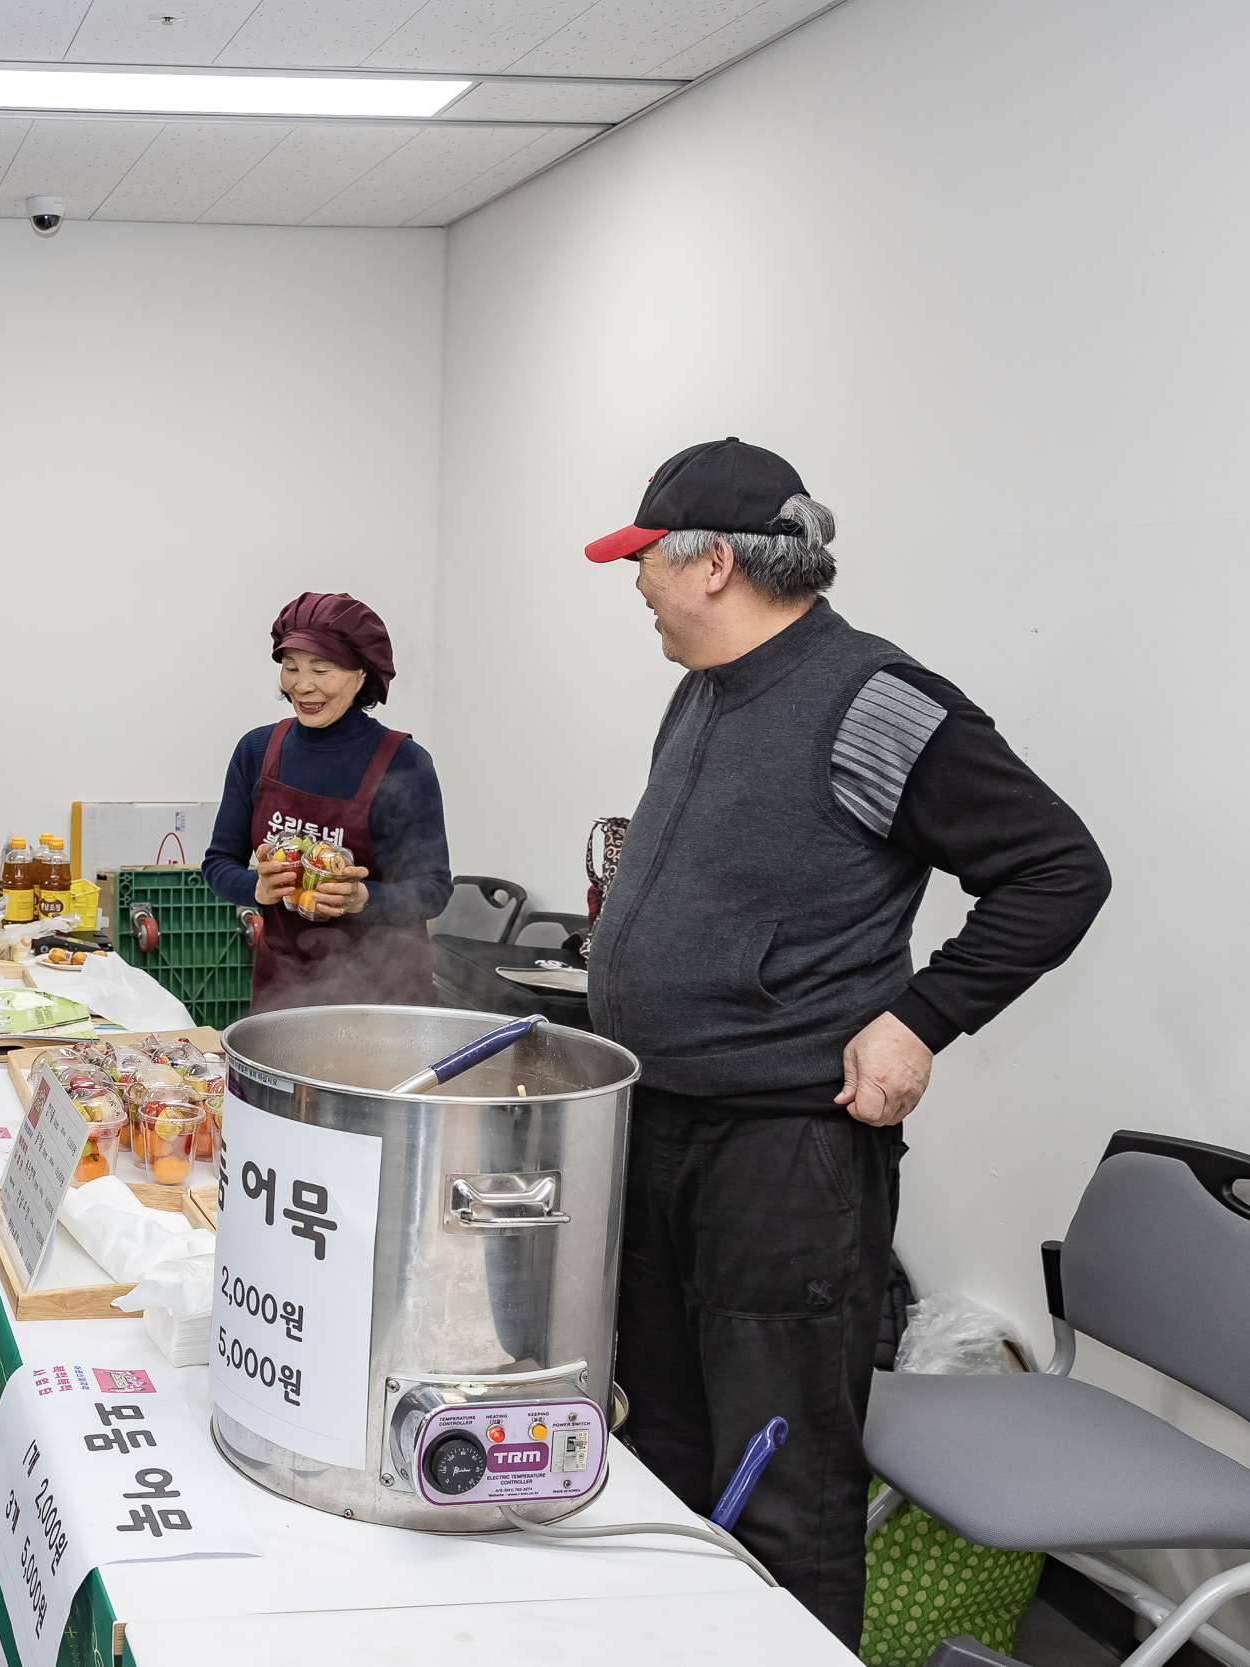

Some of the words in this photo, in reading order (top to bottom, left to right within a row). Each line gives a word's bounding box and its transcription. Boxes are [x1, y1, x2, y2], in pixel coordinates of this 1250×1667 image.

[268, 811, 344, 848] 우리동네
[241, 1160, 338, 1261] 어묵
[221, 1265, 304, 1343] 2,000원
[52, 1366, 73, 1392] 북적북적
[218, 1326, 301, 1407] 5,000원
[84, 1402, 158, 1455] 모둠
[493, 1450, 541, 1464] TRM
[22, 1439, 41, 1478] 1개
[35, 1478, 68, 1577] 2,000원
[116, 1467, 193, 1538] 어묵
[5, 1489, 21, 1534] 3개
[20, 1535, 48, 1640] 5,000원
